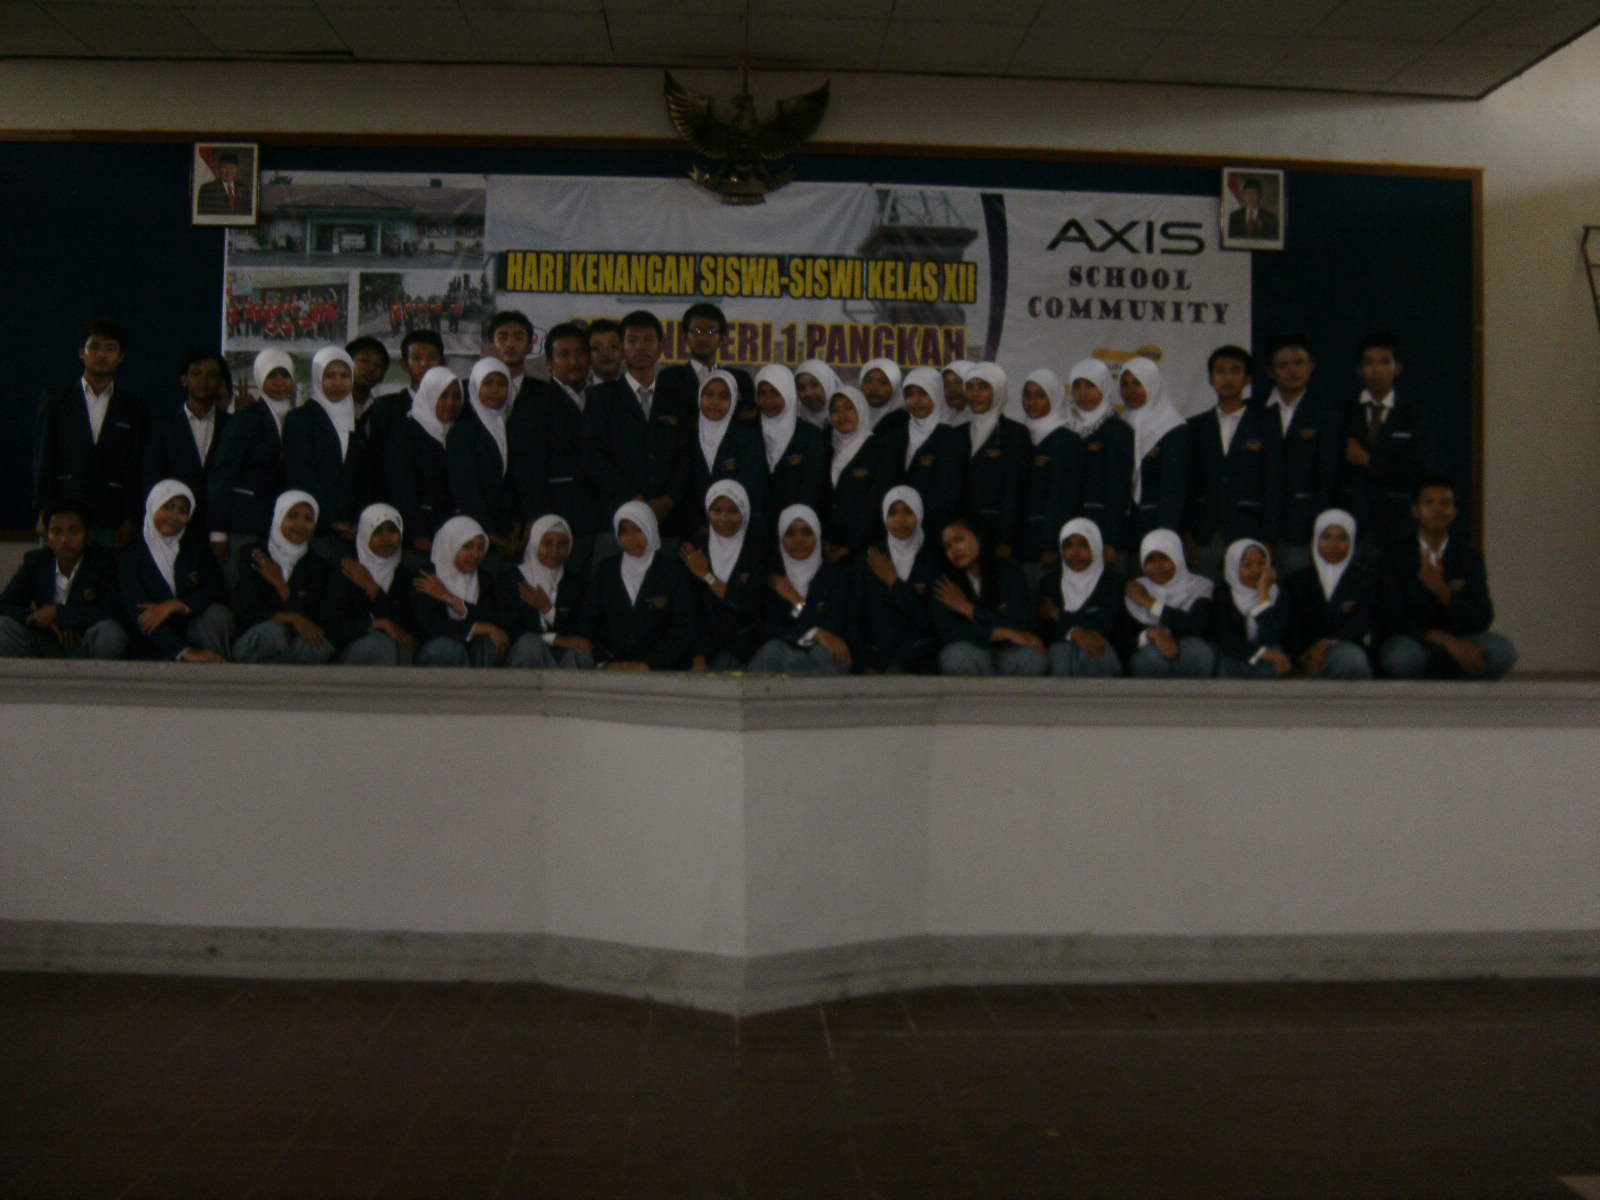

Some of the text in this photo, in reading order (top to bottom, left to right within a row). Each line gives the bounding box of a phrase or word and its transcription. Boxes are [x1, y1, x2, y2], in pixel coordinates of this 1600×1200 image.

[1046, 218, 1205, 255] AXIS
[505, 251, 978, 303] HARI KENANGAN SISWA-SISWI KELAS XII
[1068, 265, 1192, 290] SCHOOL
[1027, 296, 1229, 325] COMMUNITY
[781, 321, 799, 365] 1
[806, 321, 966, 367] PANGKAH
